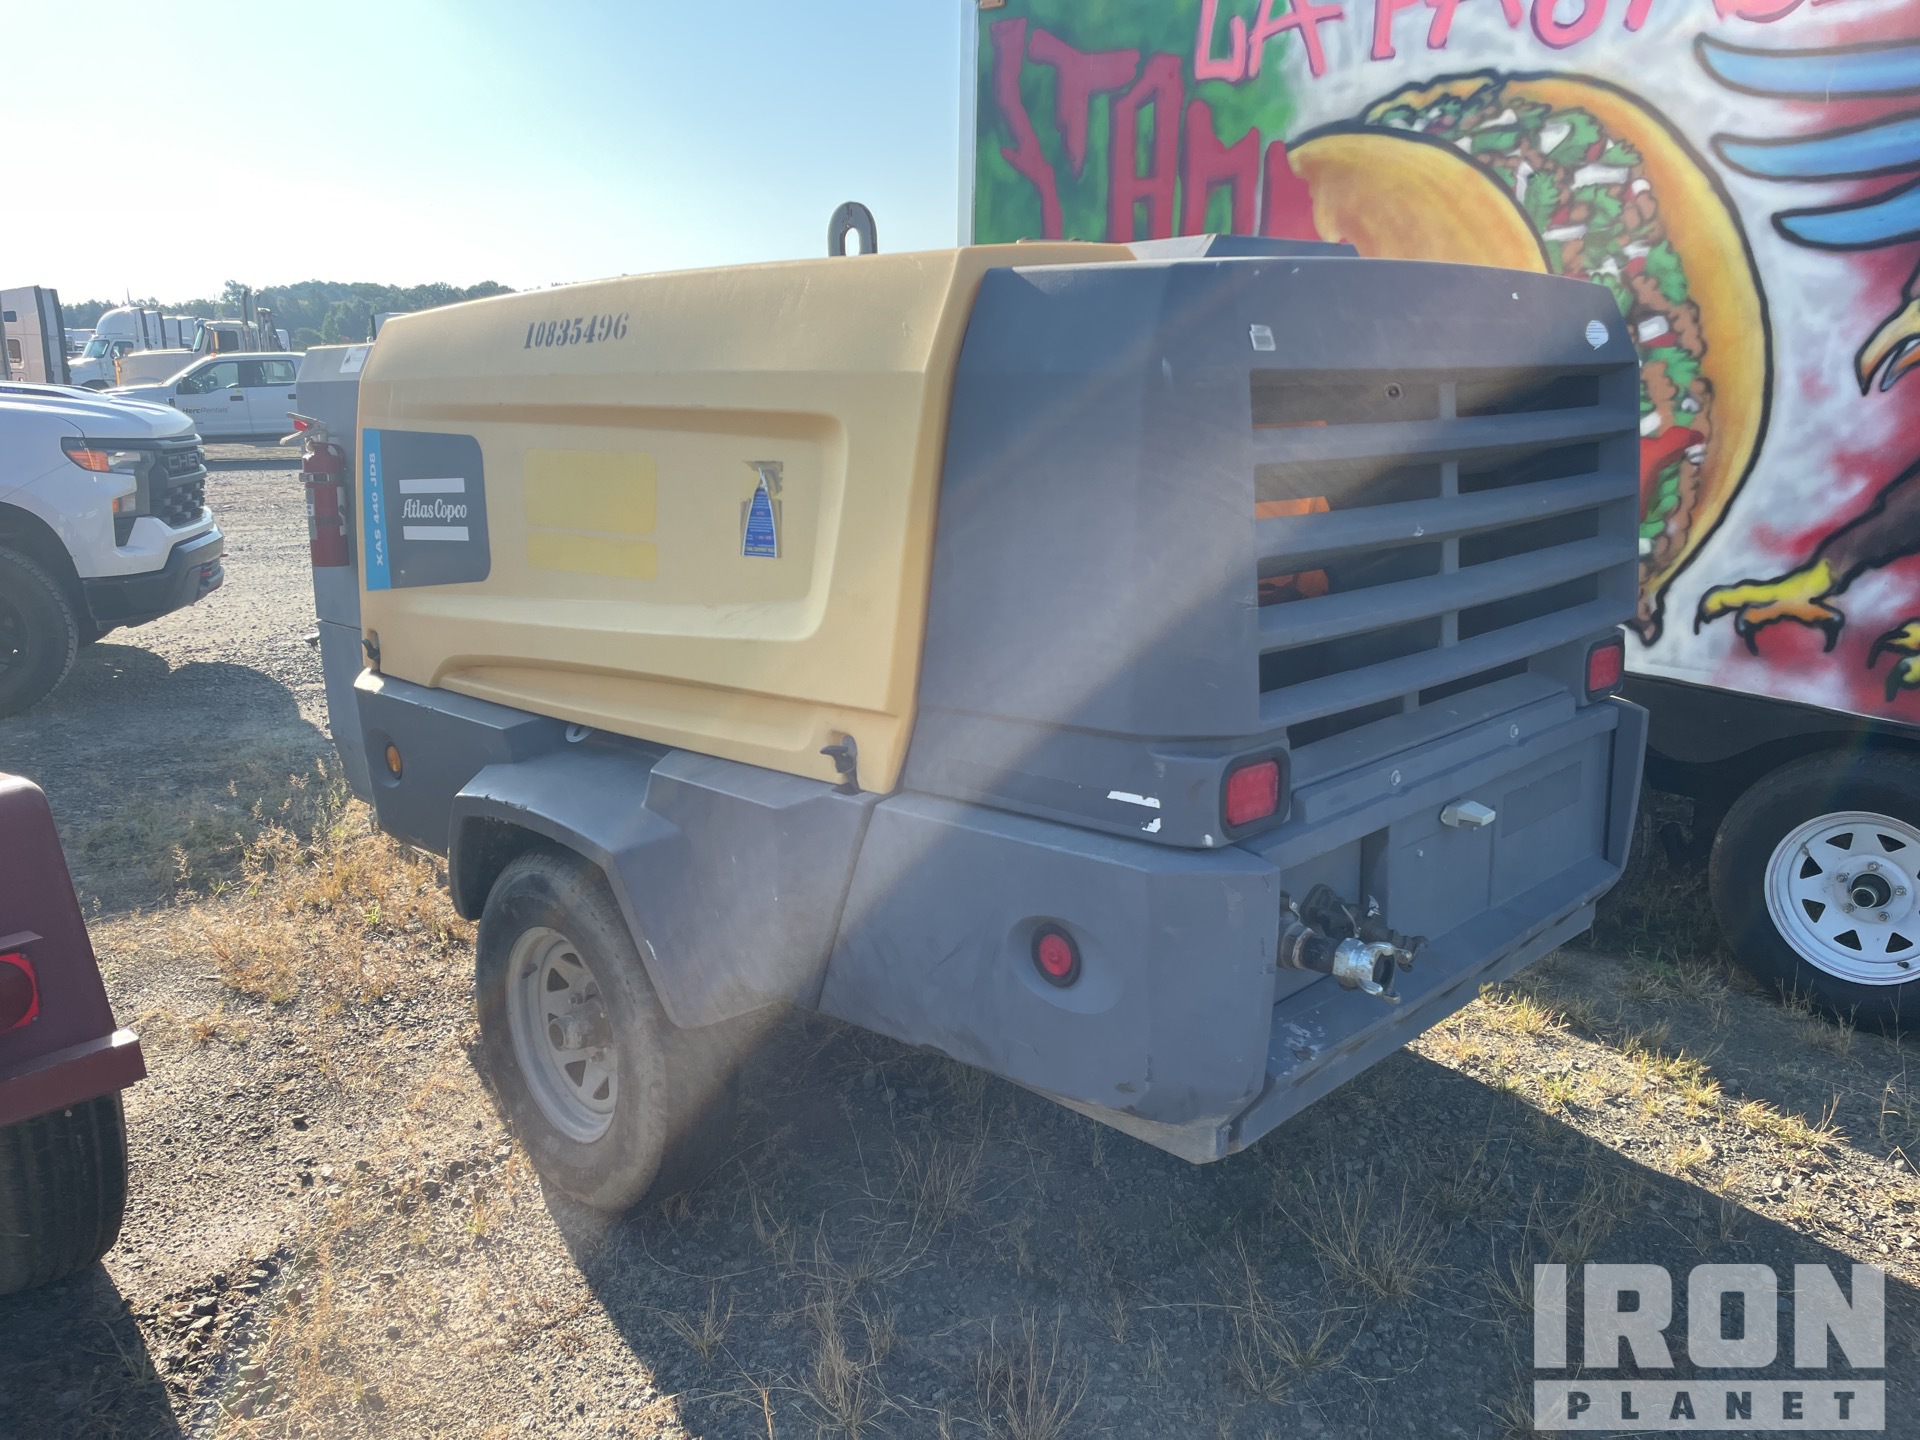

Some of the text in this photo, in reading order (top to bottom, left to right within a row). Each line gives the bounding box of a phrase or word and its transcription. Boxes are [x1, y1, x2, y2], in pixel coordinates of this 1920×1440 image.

[523, 311, 630, 350] 10835496
[368, 452, 384, 566] XAS 440 JD8
